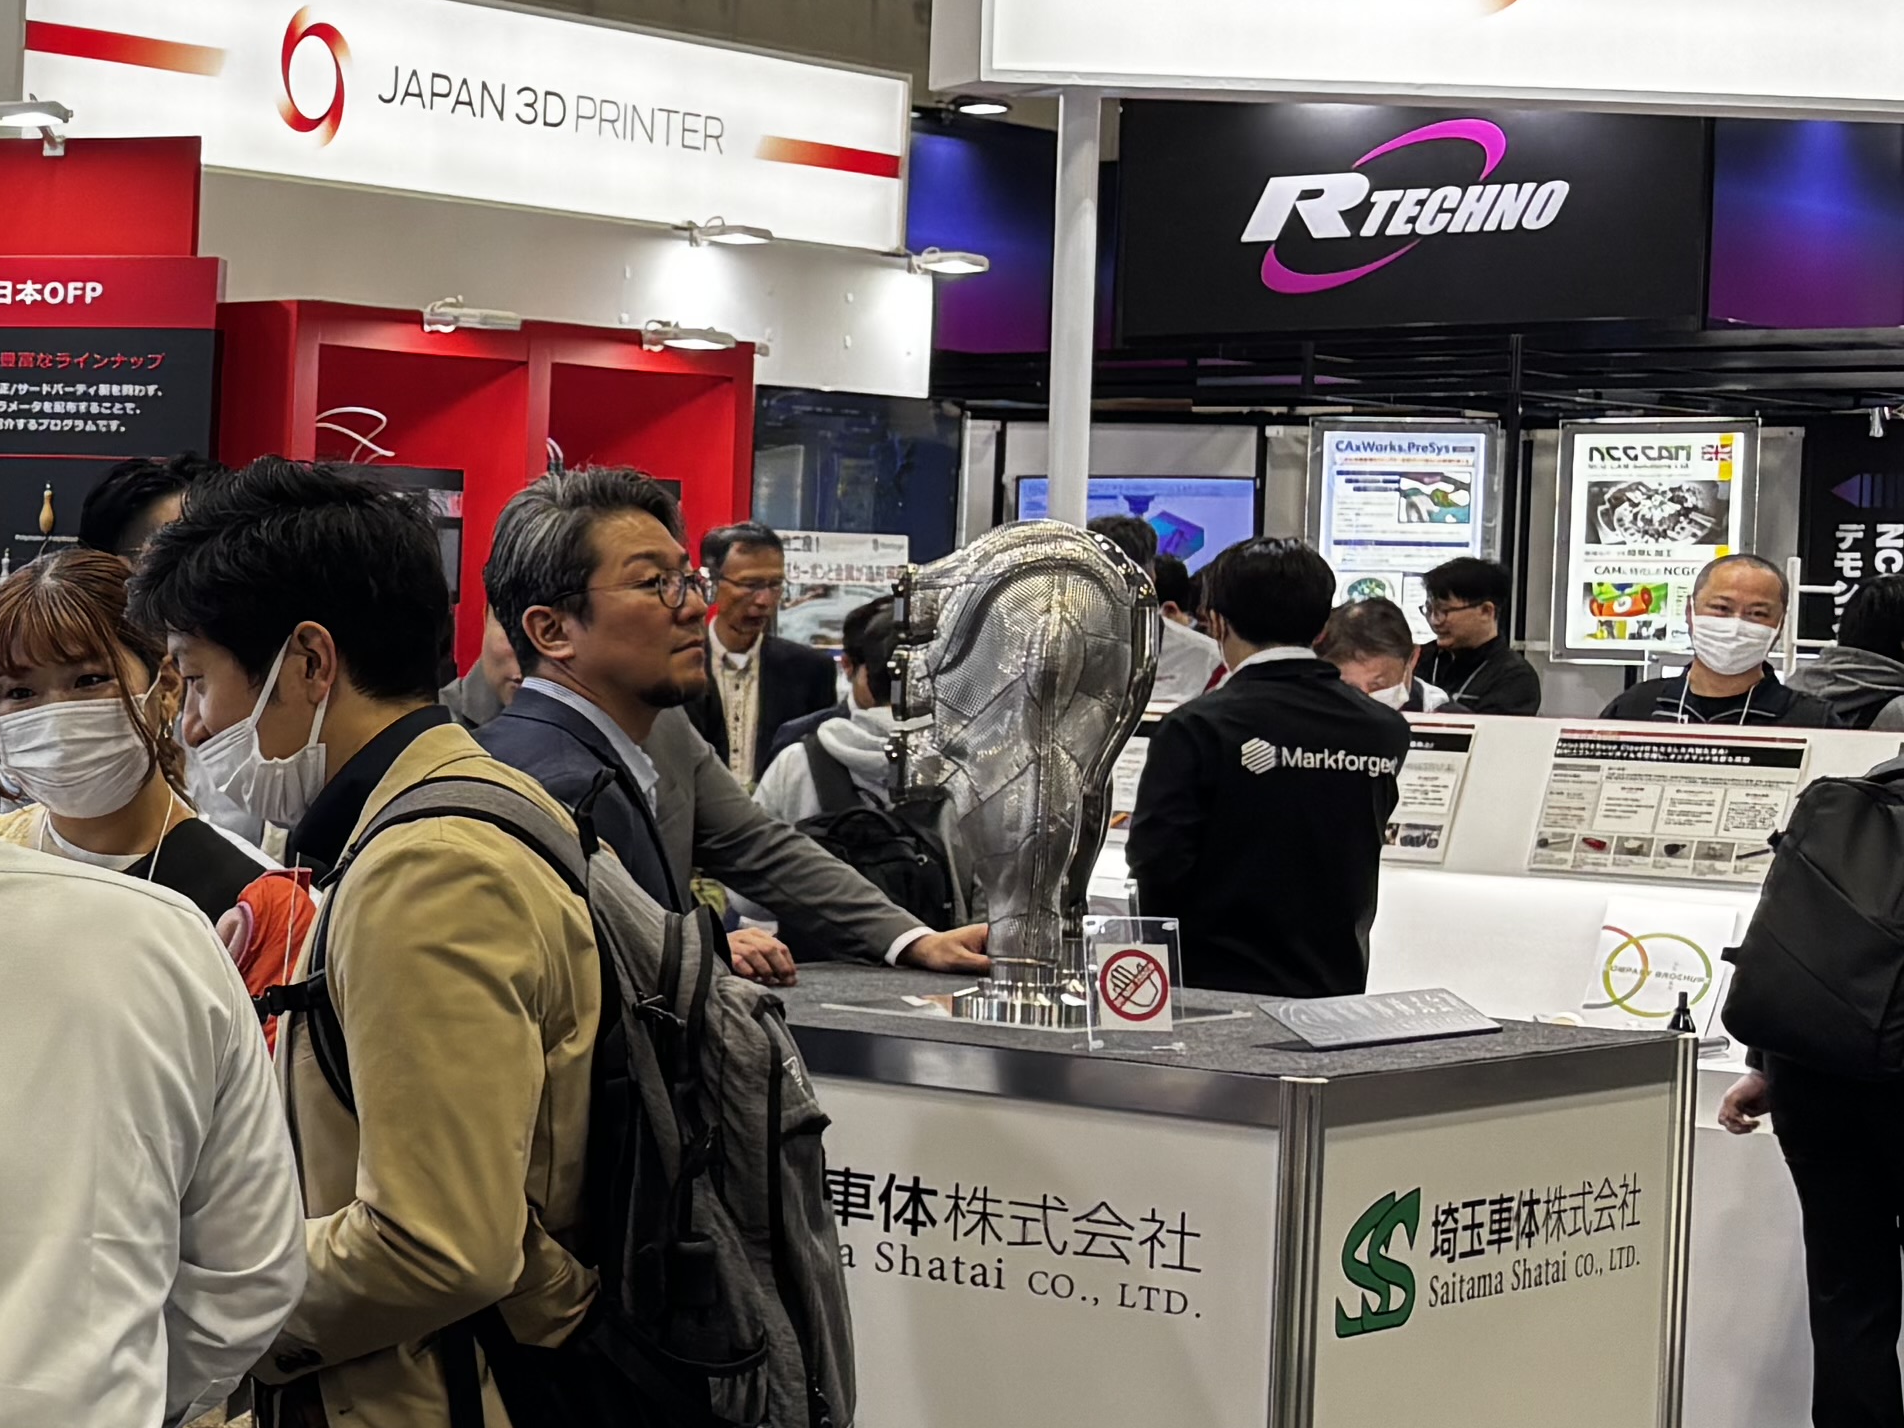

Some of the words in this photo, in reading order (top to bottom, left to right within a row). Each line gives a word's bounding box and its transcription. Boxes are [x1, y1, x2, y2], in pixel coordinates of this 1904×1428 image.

[378, 64, 505, 124] JAPAN
[516, 85, 568, 129] 3D
[574, 96, 725, 156] PRINTER
[1335, 440, 1450, 456] CAxWorks.PreSys
[824, 1167, 1202, 1273] 車体株式会社
[1430, 1172, 1642, 1263] 埼玉車体株式会社
[875, 1240, 1006, 1291] Shatai
[1028, 1270, 1100, 1307] CO.,
[1118, 1283, 1202, 1319] LTD.
[1429, 1275, 1504, 1308] Saitama
[1511, 1250, 1567, 1292] Shatai
[1575, 1253, 1603, 1279] CO.,
[1609, 1245, 1641, 1271] LTD.
